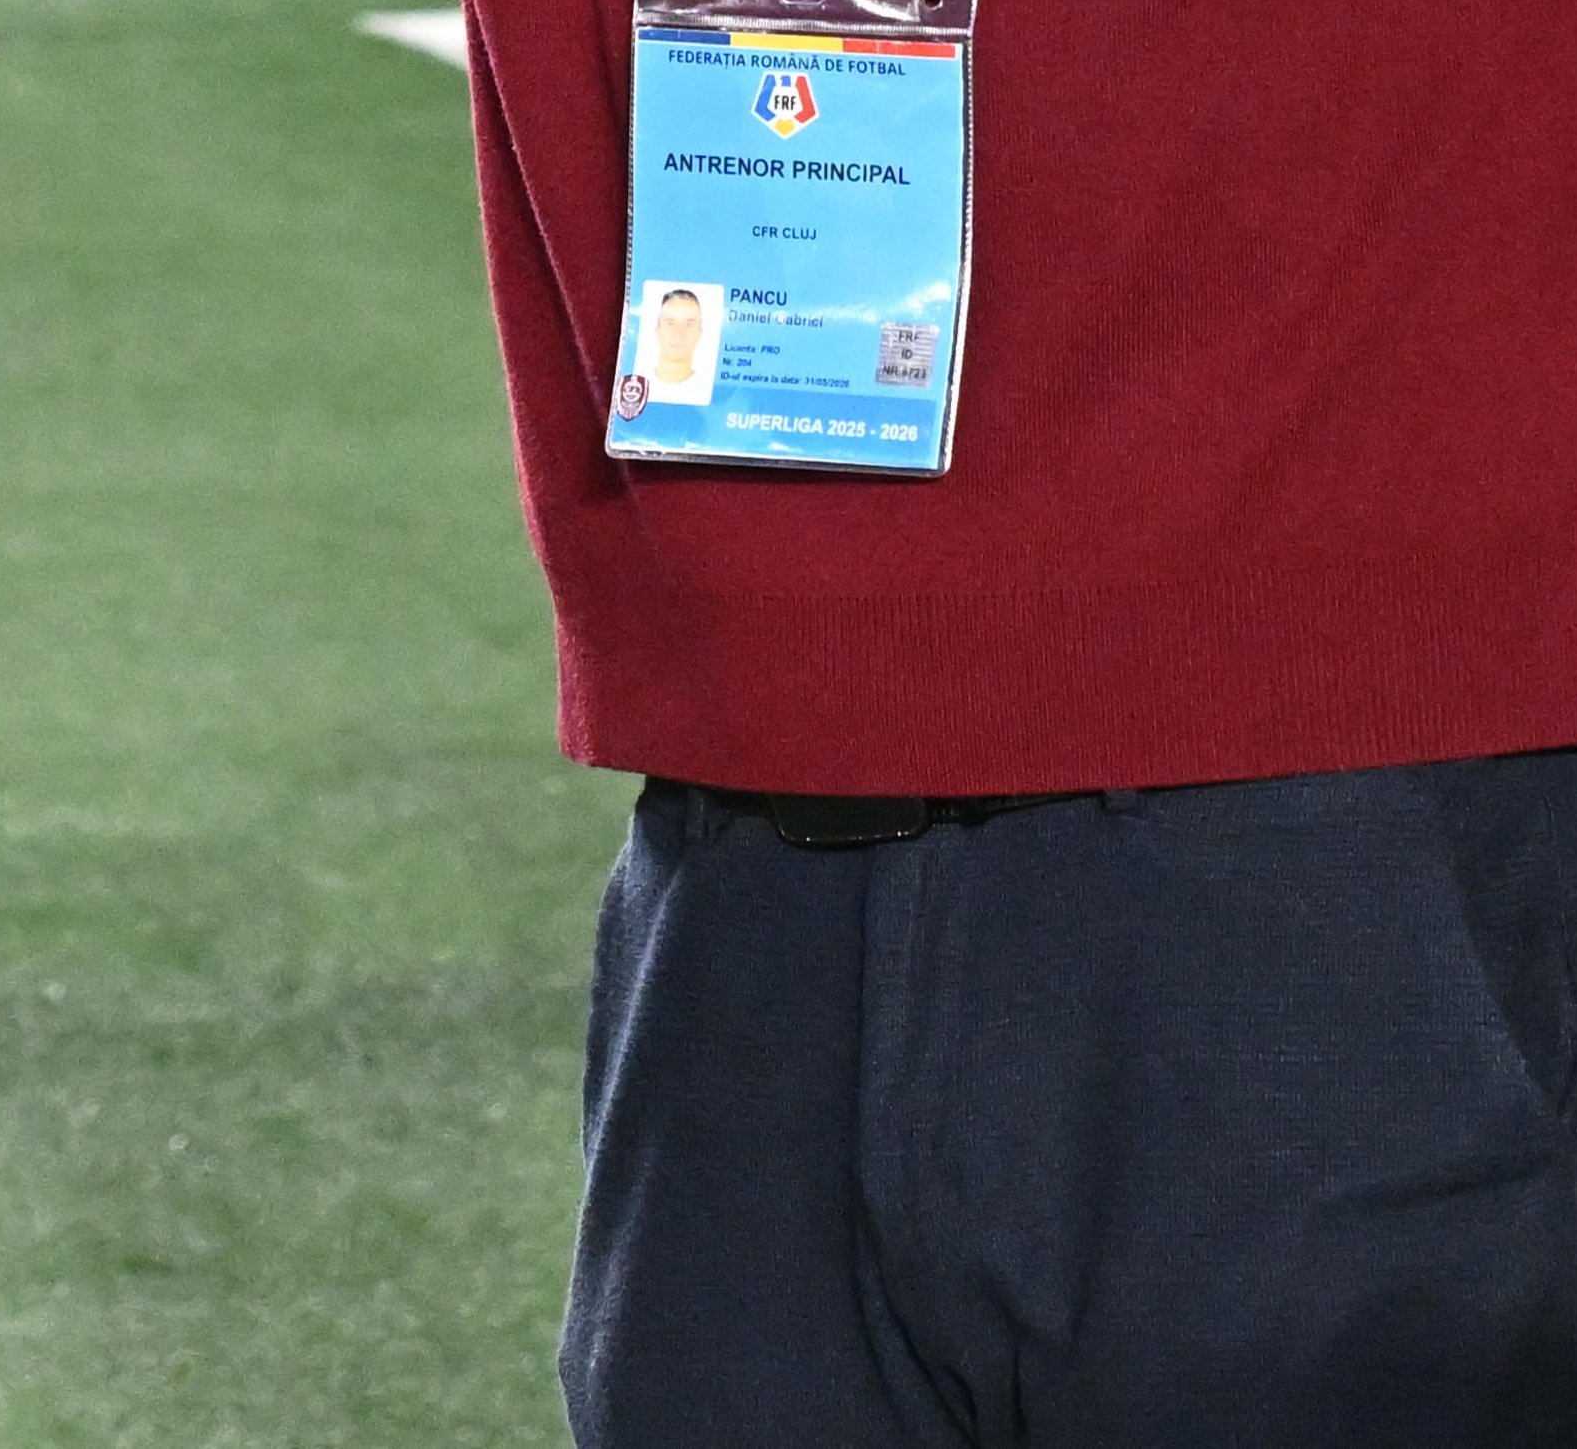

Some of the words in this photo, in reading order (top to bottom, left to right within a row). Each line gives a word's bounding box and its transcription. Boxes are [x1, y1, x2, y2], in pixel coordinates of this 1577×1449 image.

[668, 49, 746, 70] FEDERAȚIA
[751, 52, 820, 71] ROMÂNĂ
[825, 59, 843, 72] DE
[848, 60, 906, 76] FOTBAL
[774, 94, 797, 111] FRF
[664, 152, 785, 179] ANTRENOR
[792, 160, 911, 185] PRINCIPAL
[752, 225, 778, 239] CFR
[782, 227, 817, 241] CLUJ
[730, 287, 788, 307] PANCU
[728, 308, 771, 325] Daniel
[901, 348, 913, 360] ID
[725, 411, 824, 435] SUPERLIGA
[826, 419, 866, 438] 2025
[879, 423, 919, 442] 2026
